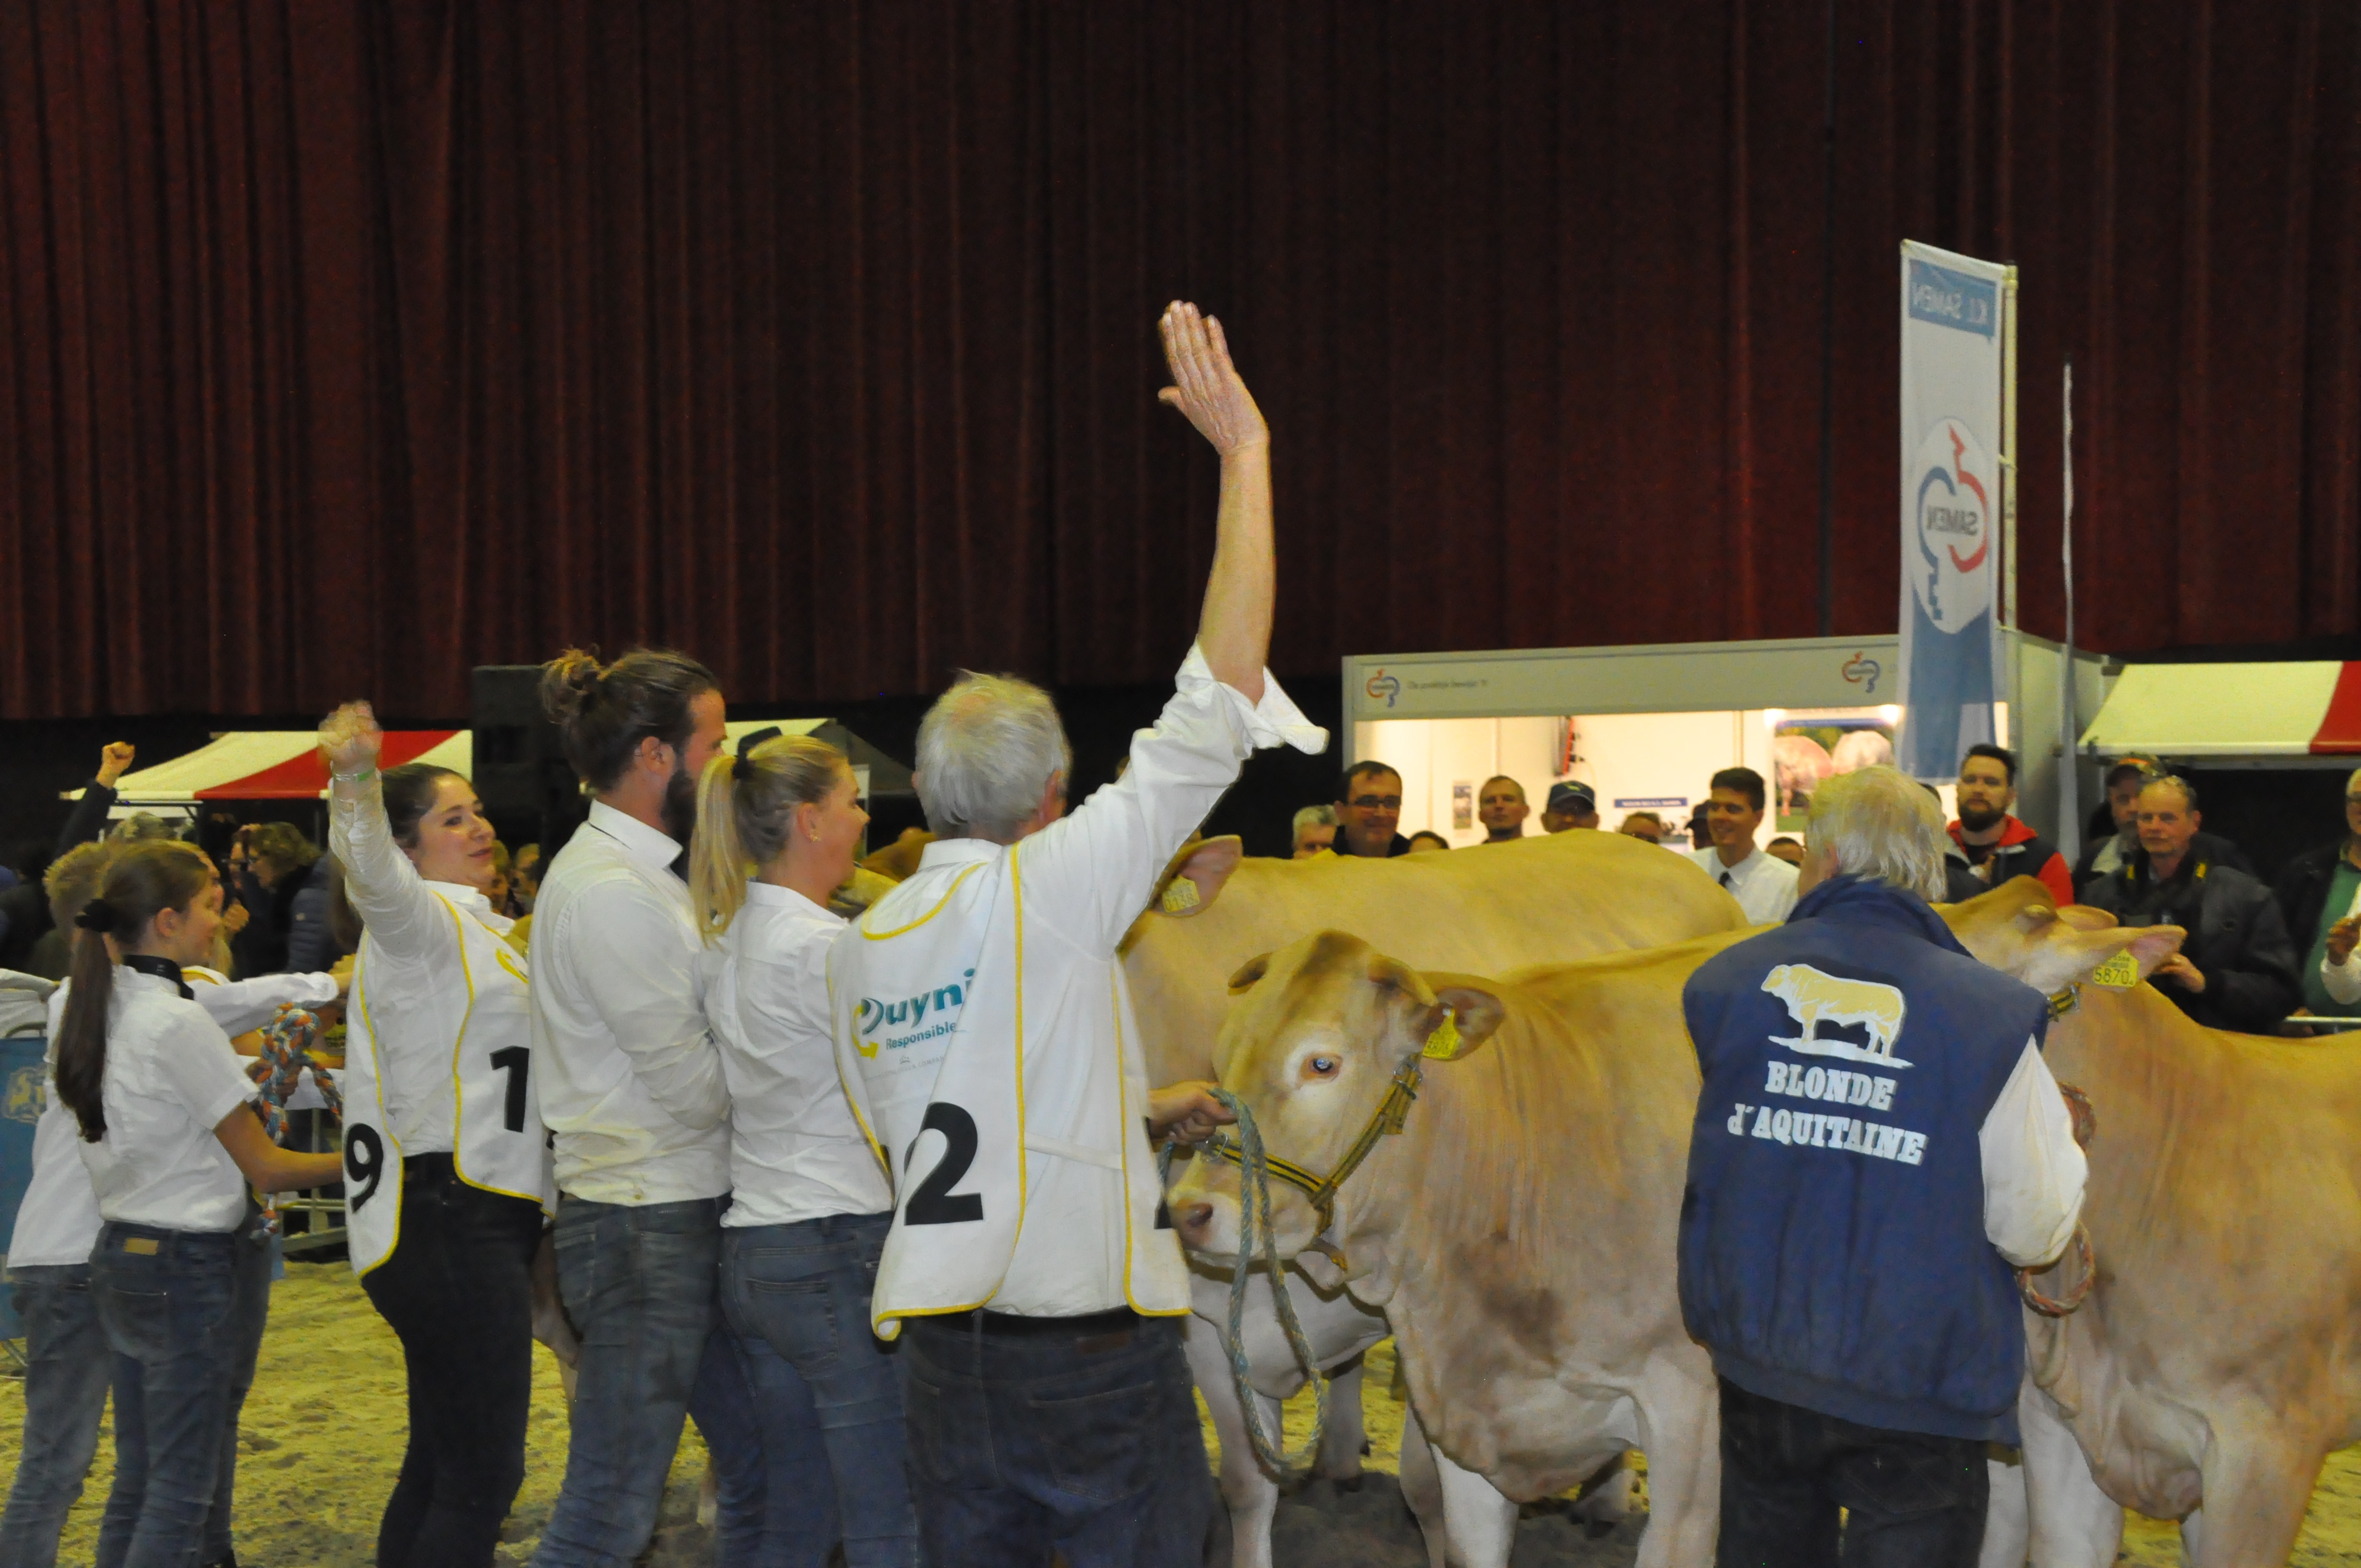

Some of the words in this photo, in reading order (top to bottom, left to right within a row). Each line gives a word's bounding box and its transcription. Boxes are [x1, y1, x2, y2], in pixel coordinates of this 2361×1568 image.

[2094, 966, 2130, 984] 5870
[885, 1021, 956, 1050] Responsible
[1765, 1060, 1898, 1112] BLONDE
[345, 1122, 384, 1214] 9
[903, 1102, 984, 1226] 2
